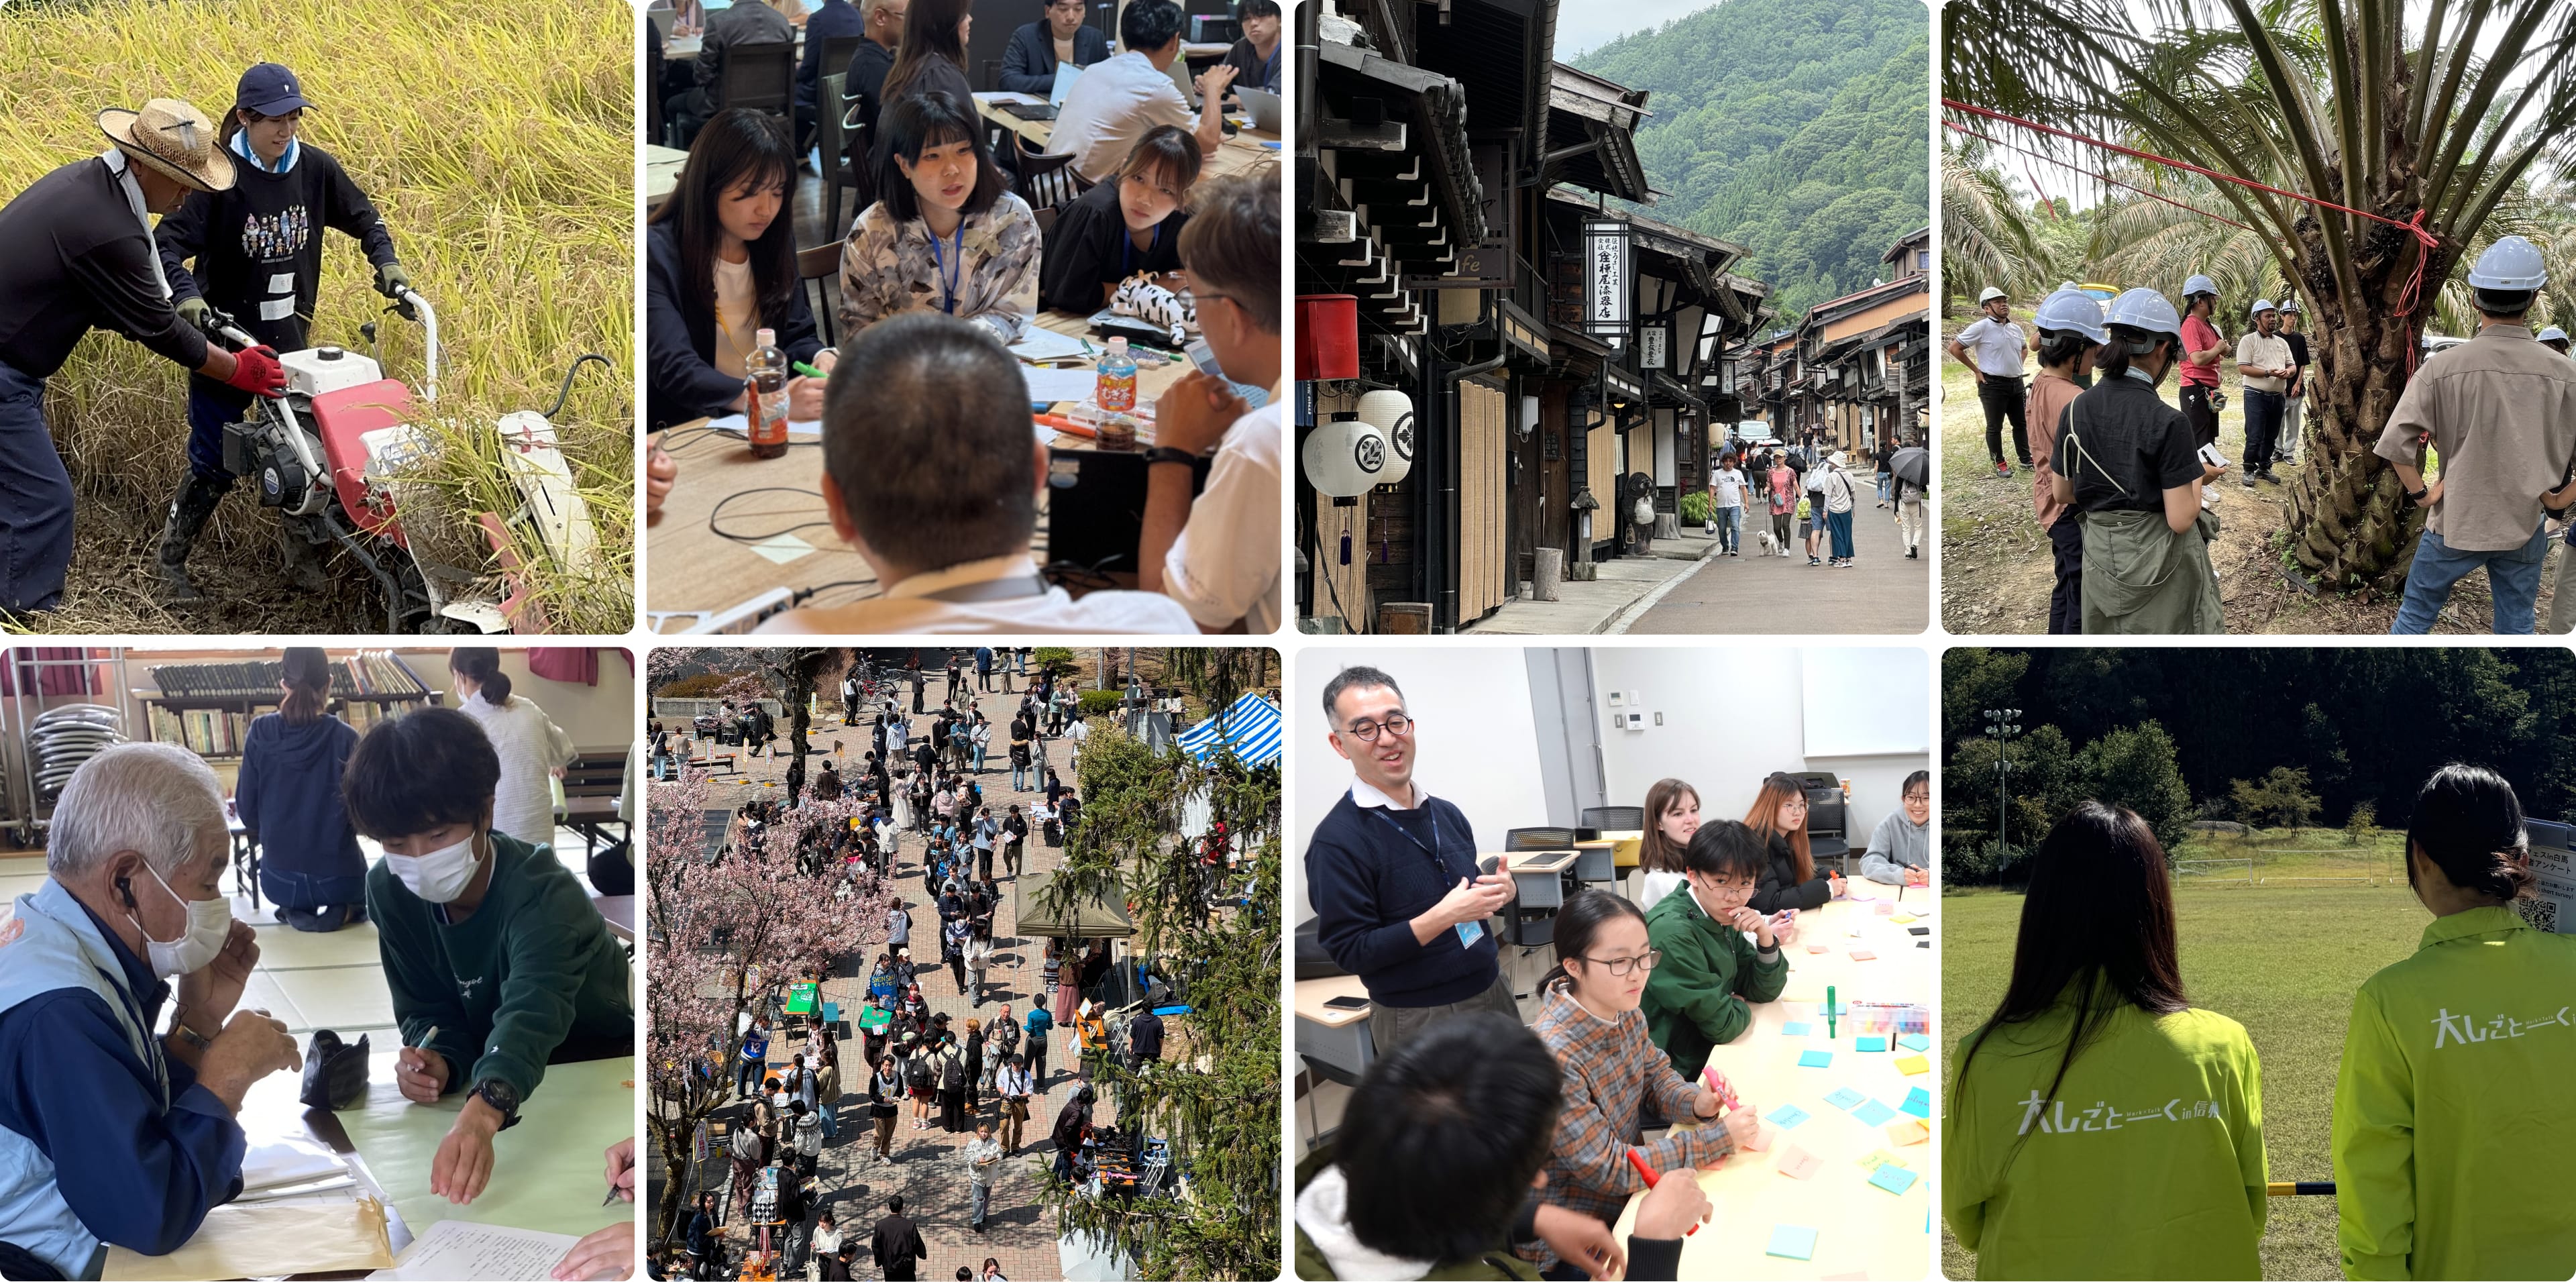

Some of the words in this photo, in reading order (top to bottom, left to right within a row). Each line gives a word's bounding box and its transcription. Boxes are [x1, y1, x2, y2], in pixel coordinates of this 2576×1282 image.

[1462, 254, 1481, 272] fe
[1102, 386, 1131, 401] むぎ茶
[266, 471, 278, 482] OHV
[751, 1042, 761, 1053] 12
